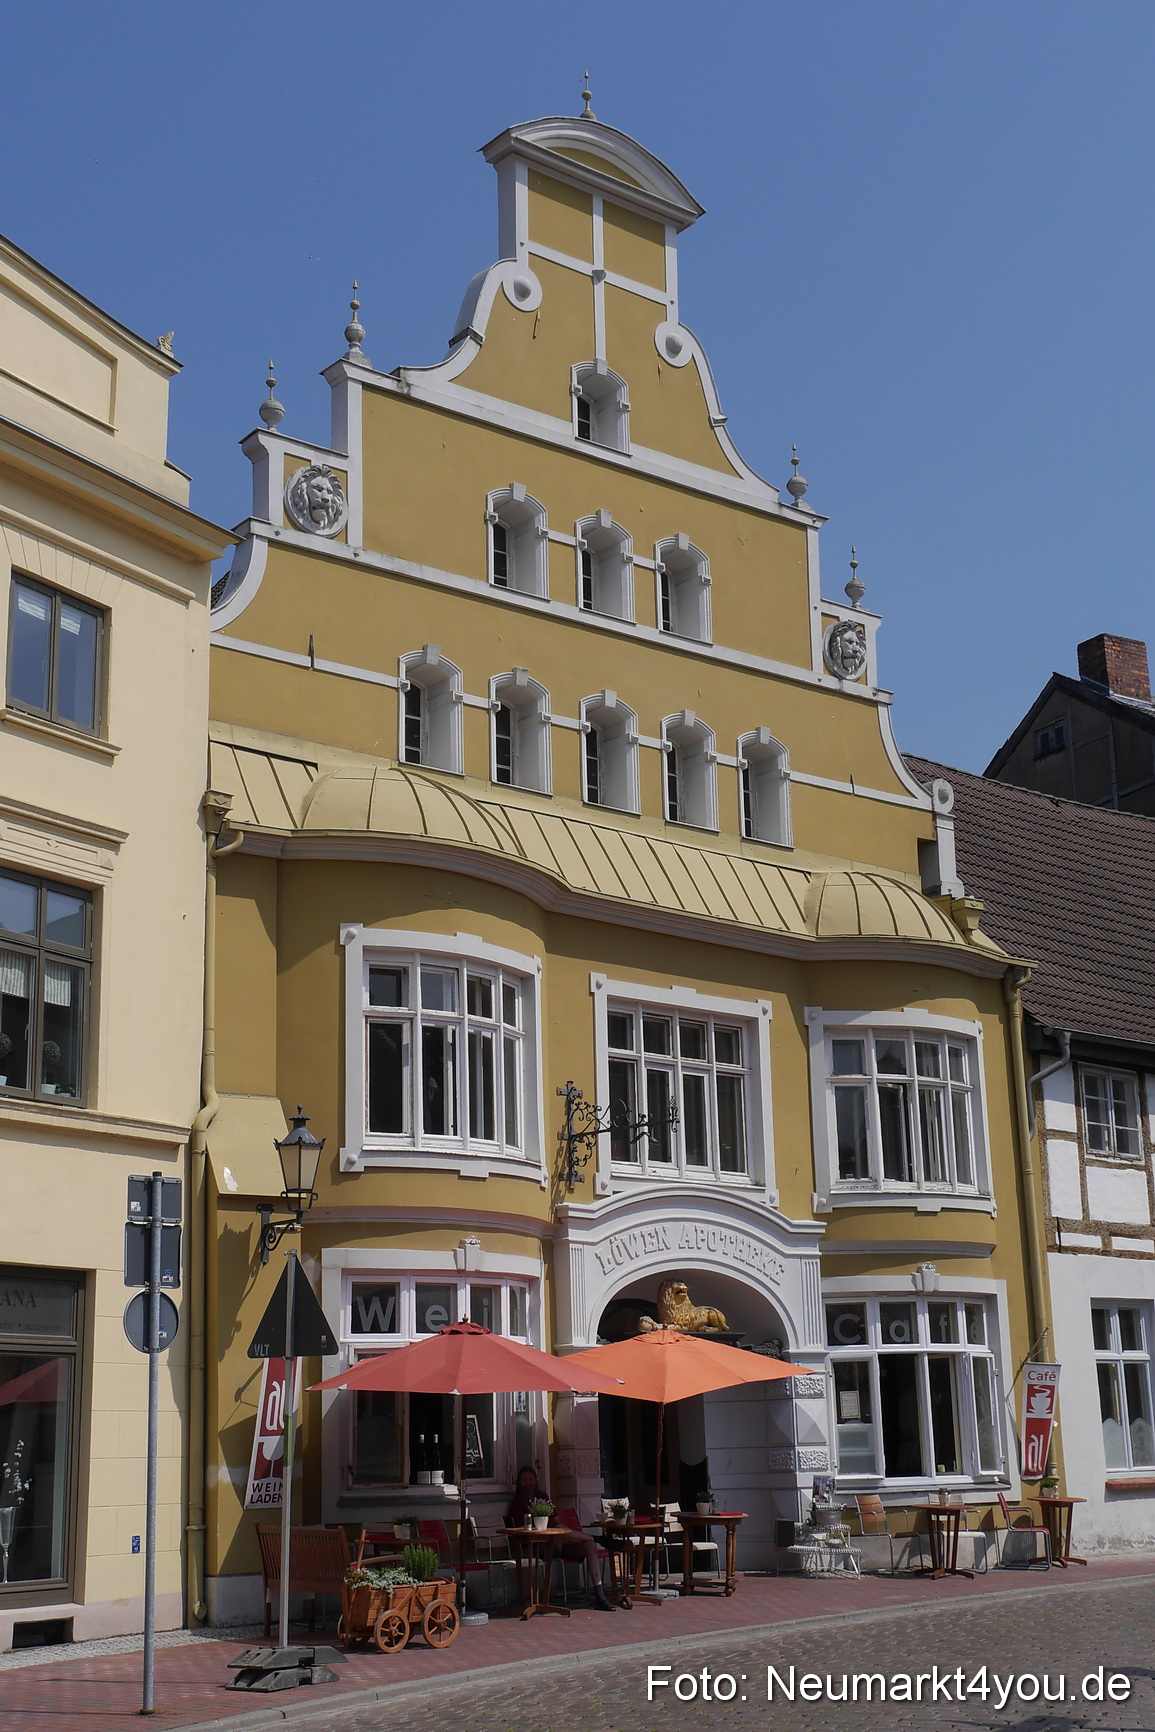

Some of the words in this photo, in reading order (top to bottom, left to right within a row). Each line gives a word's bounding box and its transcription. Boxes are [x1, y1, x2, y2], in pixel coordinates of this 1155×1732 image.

[595, 1224, 671, 1276] LÖWEN
[678, 1224, 785, 1287] APOTHEKE
[254, 1344, 270, 1357] VLT
[1027, 1370, 1057, 1381] Café
